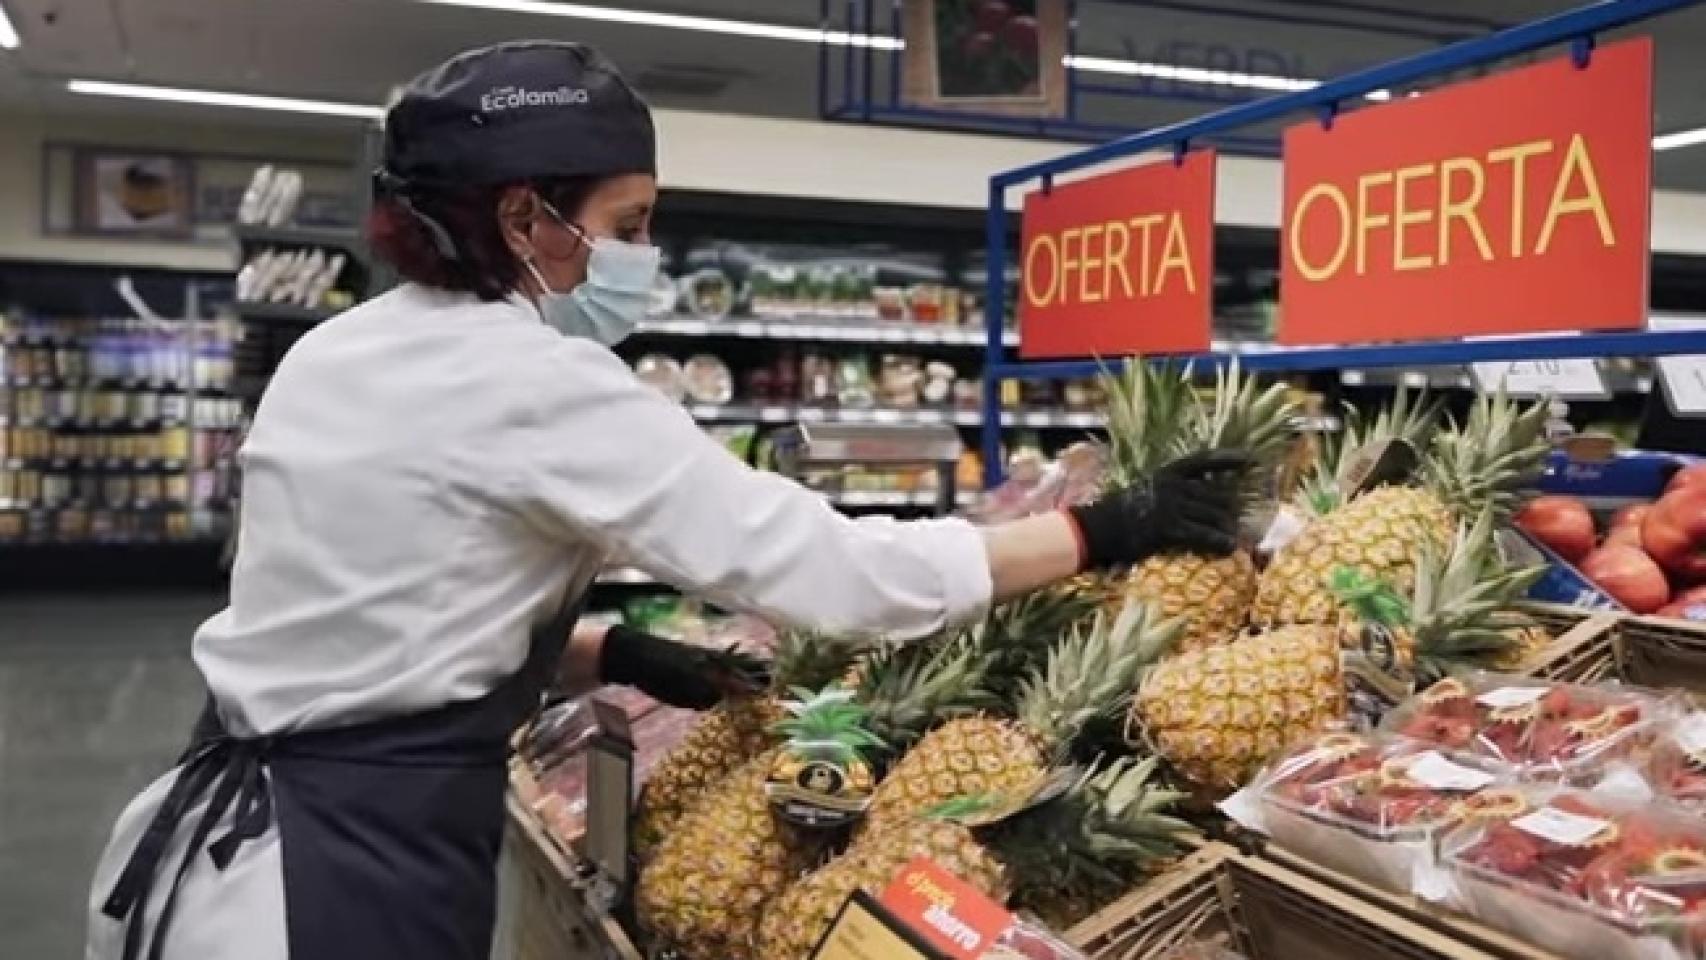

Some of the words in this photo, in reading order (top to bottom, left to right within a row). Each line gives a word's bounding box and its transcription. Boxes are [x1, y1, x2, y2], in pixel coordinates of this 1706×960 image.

[481, 86, 589, 112] Ecofamilia
[1290, 134, 1614, 281] OFERTA
[1025, 211, 1196, 307] OFERTA
